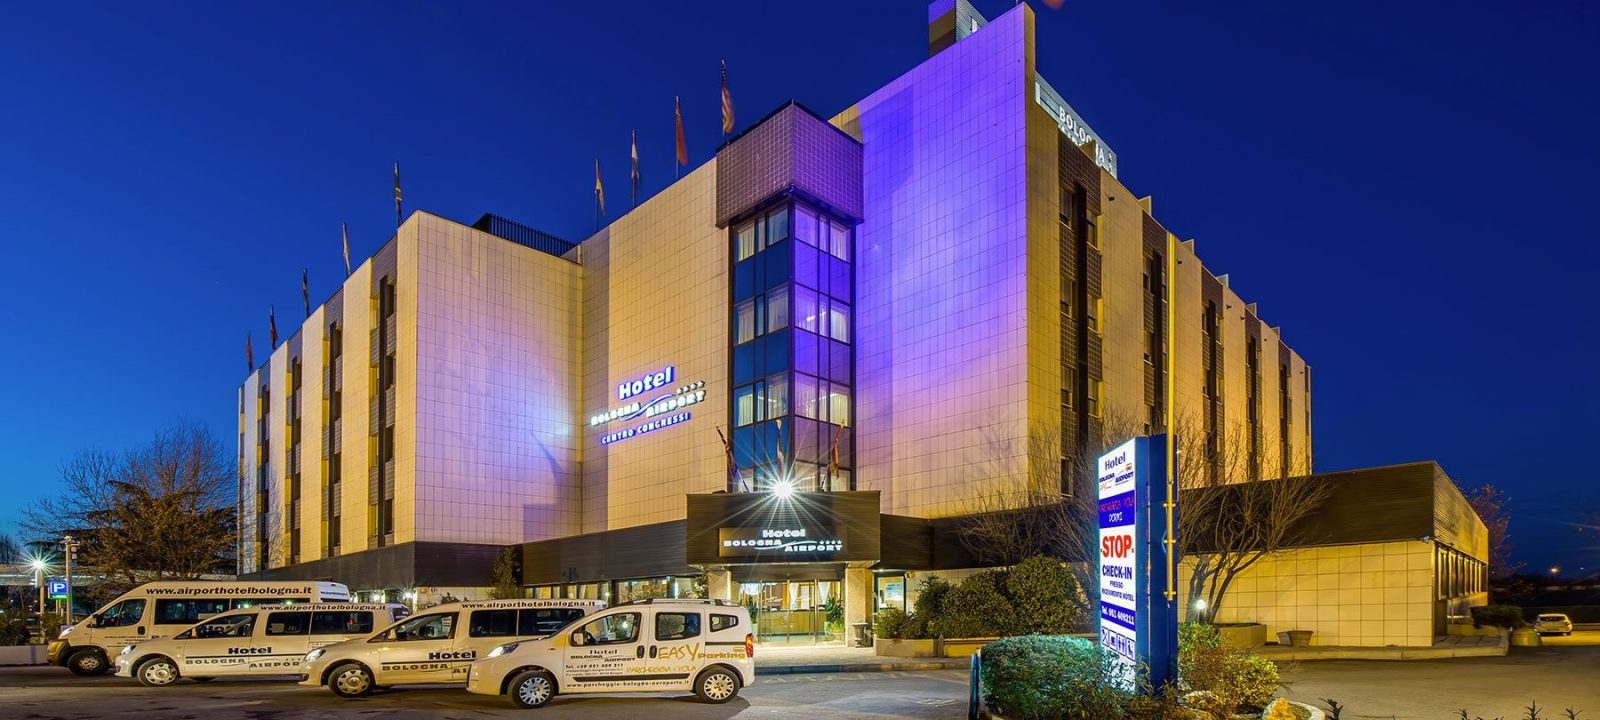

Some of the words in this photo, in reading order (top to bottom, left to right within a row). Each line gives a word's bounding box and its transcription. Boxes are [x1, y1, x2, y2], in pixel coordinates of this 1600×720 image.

[619, 366, 674, 400] Hotel
[590, 402, 641, 426] BOLOGNA
[645, 390, 706, 418] AIRPORT
[601, 429, 636, 444] CENTRO
[637, 412, 691, 434] CONGRESSI
[1105, 452, 1126, 470] Hotel
[762, 529, 806, 538] Hotel
[723, 539, 782, 547] BOLOGNA
[1102, 564, 1132, 580] CHECK-IN
[53, 583, 65, 593] P
[1109, 580, 1123, 589] PRESSO
[146, 586, 312, 596] www.airporthotelbologna.it
[1122, 593, 1134, 601] HOTEL
[260, 604, 386, 612] www.airporthotelbologna.it
[461, 600, 596, 609] www.airporthotelbologna.it
[228, 646, 272, 655] Hotel
[658, 642, 700, 661] EASY
[428, 651, 477, 660] Hotel
[382, 663, 448, 671] BOLOGNA
[678, 665, 697, 673] VOLA
